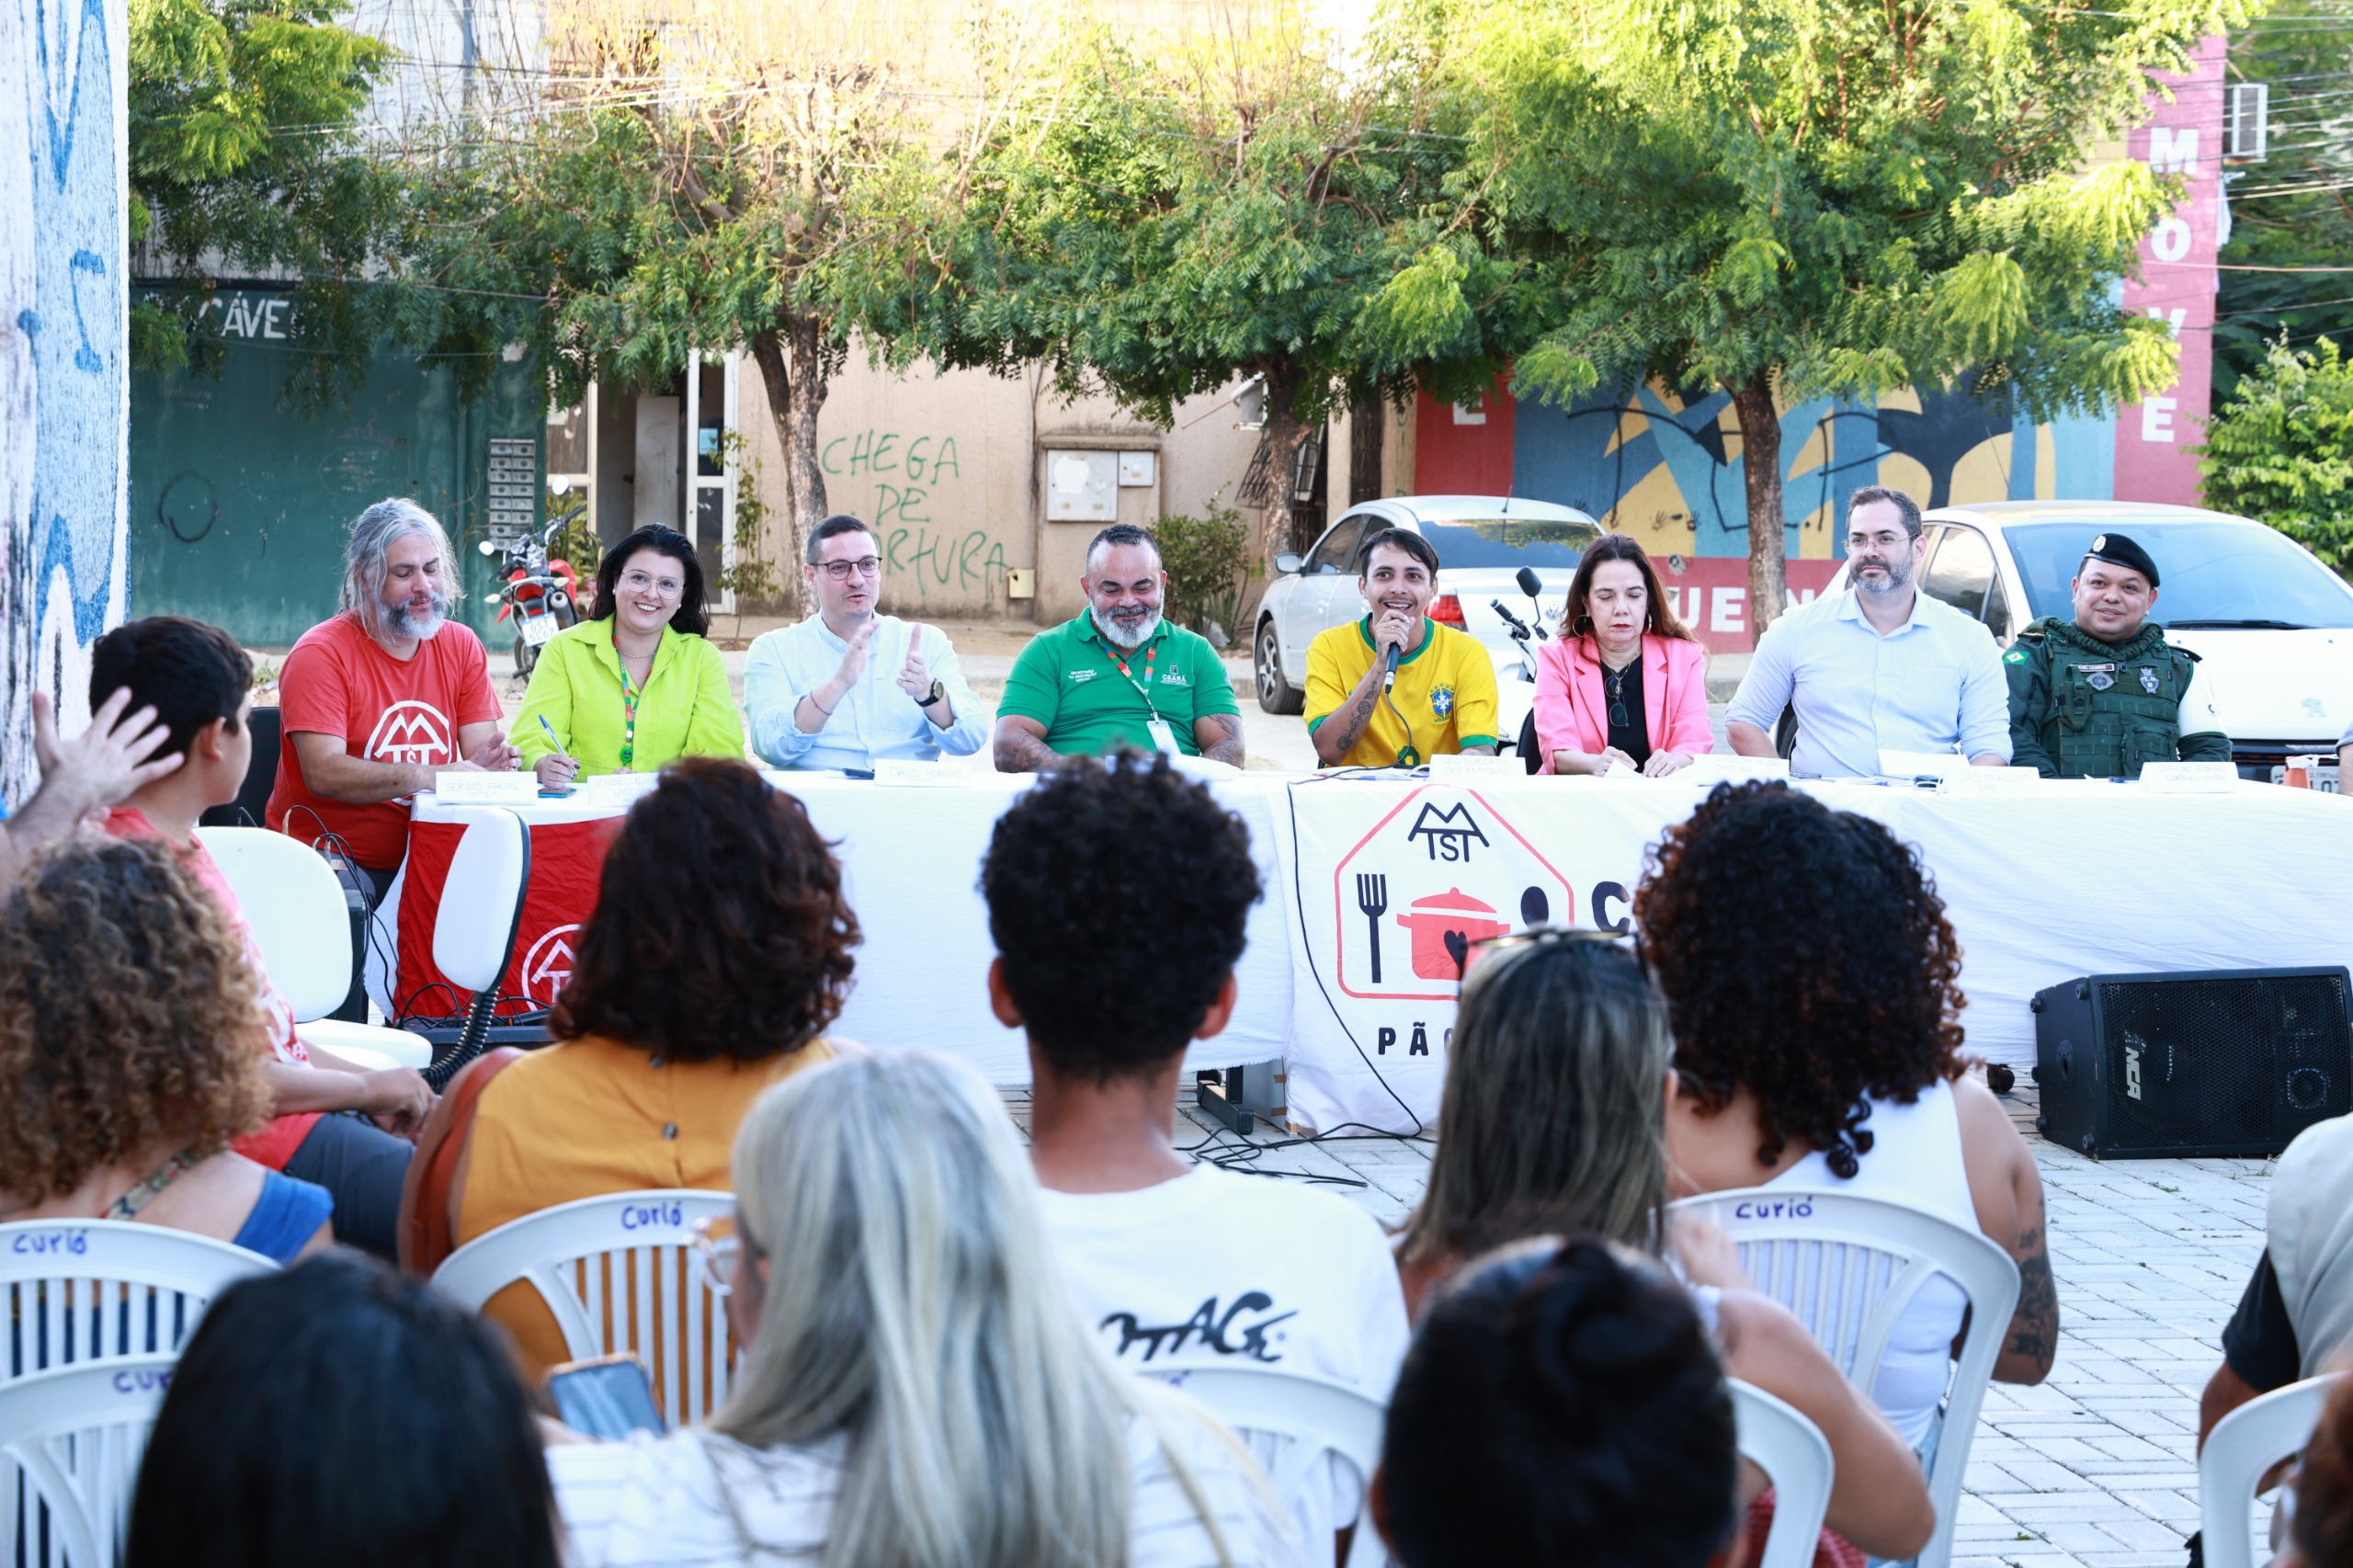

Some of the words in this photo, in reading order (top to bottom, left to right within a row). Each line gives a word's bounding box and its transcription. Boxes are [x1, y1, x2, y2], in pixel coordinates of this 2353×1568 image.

[822, 430, 959, 484] CHEGA
[875, 484, 929, 526] DE
[875, 528, 1010, 599] RTURA
[1378, 1021, 1454, 1056] PÃ
